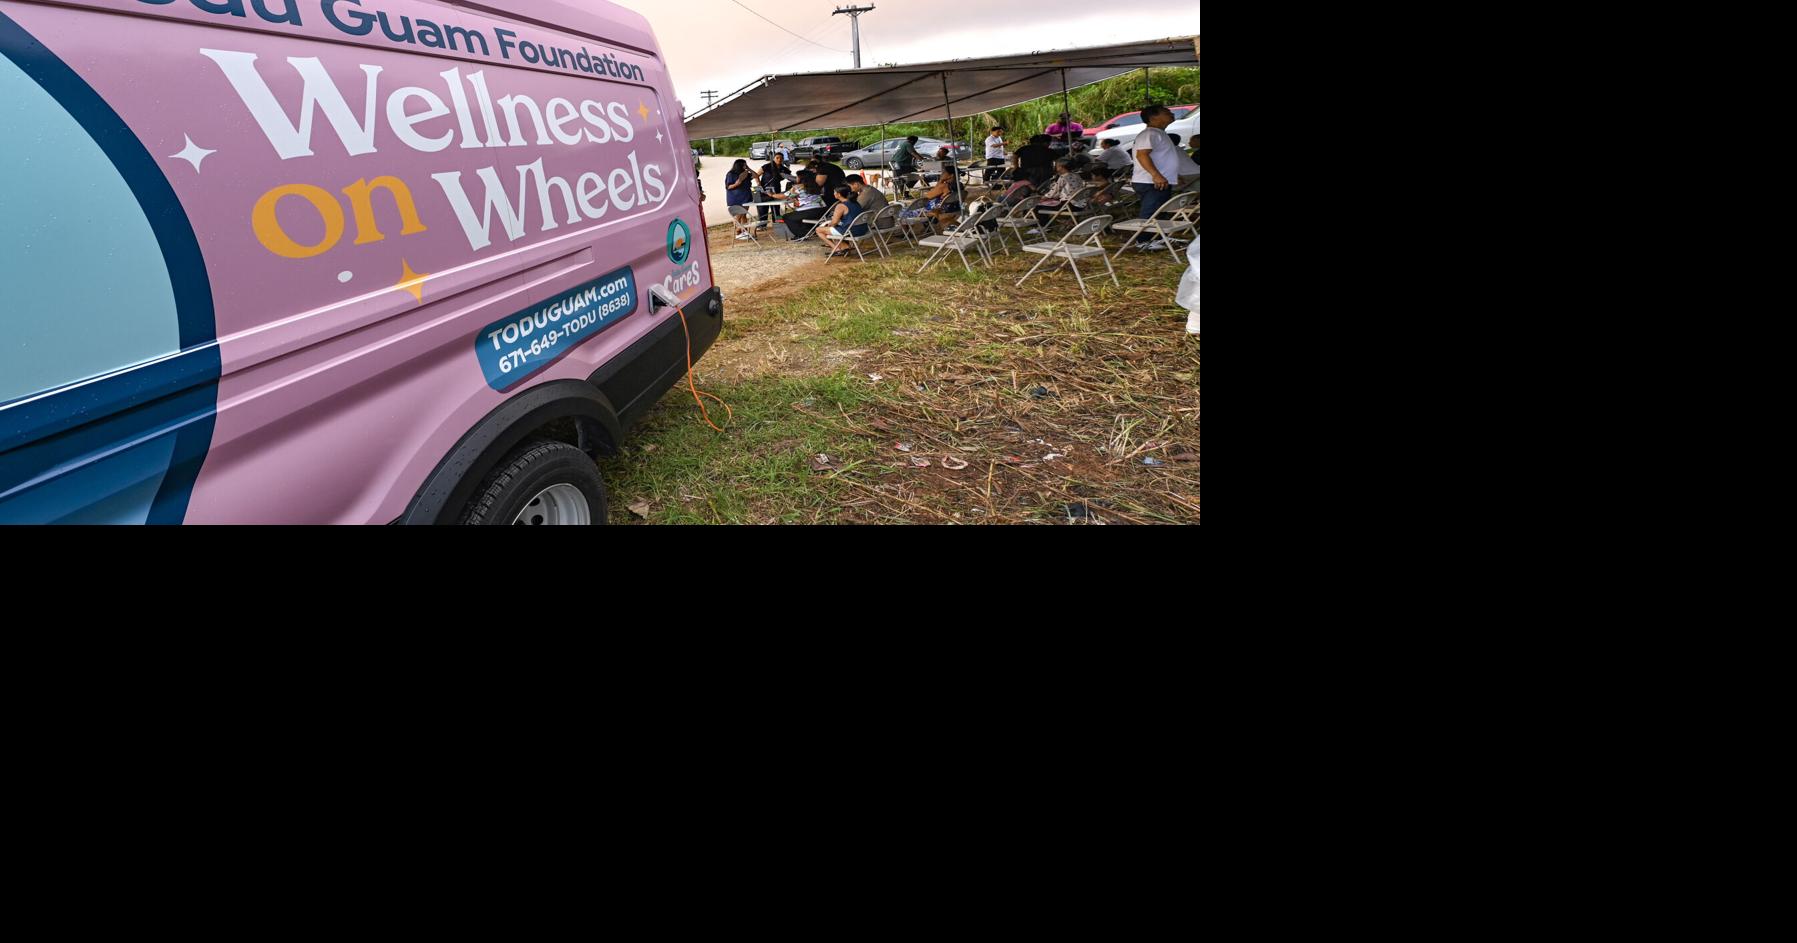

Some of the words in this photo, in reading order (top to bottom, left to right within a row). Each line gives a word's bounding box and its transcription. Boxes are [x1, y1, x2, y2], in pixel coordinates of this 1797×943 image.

[319, 0, 490, 56] Guam
[494, 27, 645, 82] Foundation
[199, 47, 634, 160] Wellness
[251, 174, 428, 259] on
[431, 150, 666, 252] Wheels
[488, 275, 628, 351] TODUGUAM.com
[498, 309, 597, 374] 671-649-TODU
[598, 292, 630, 321] (8638)
